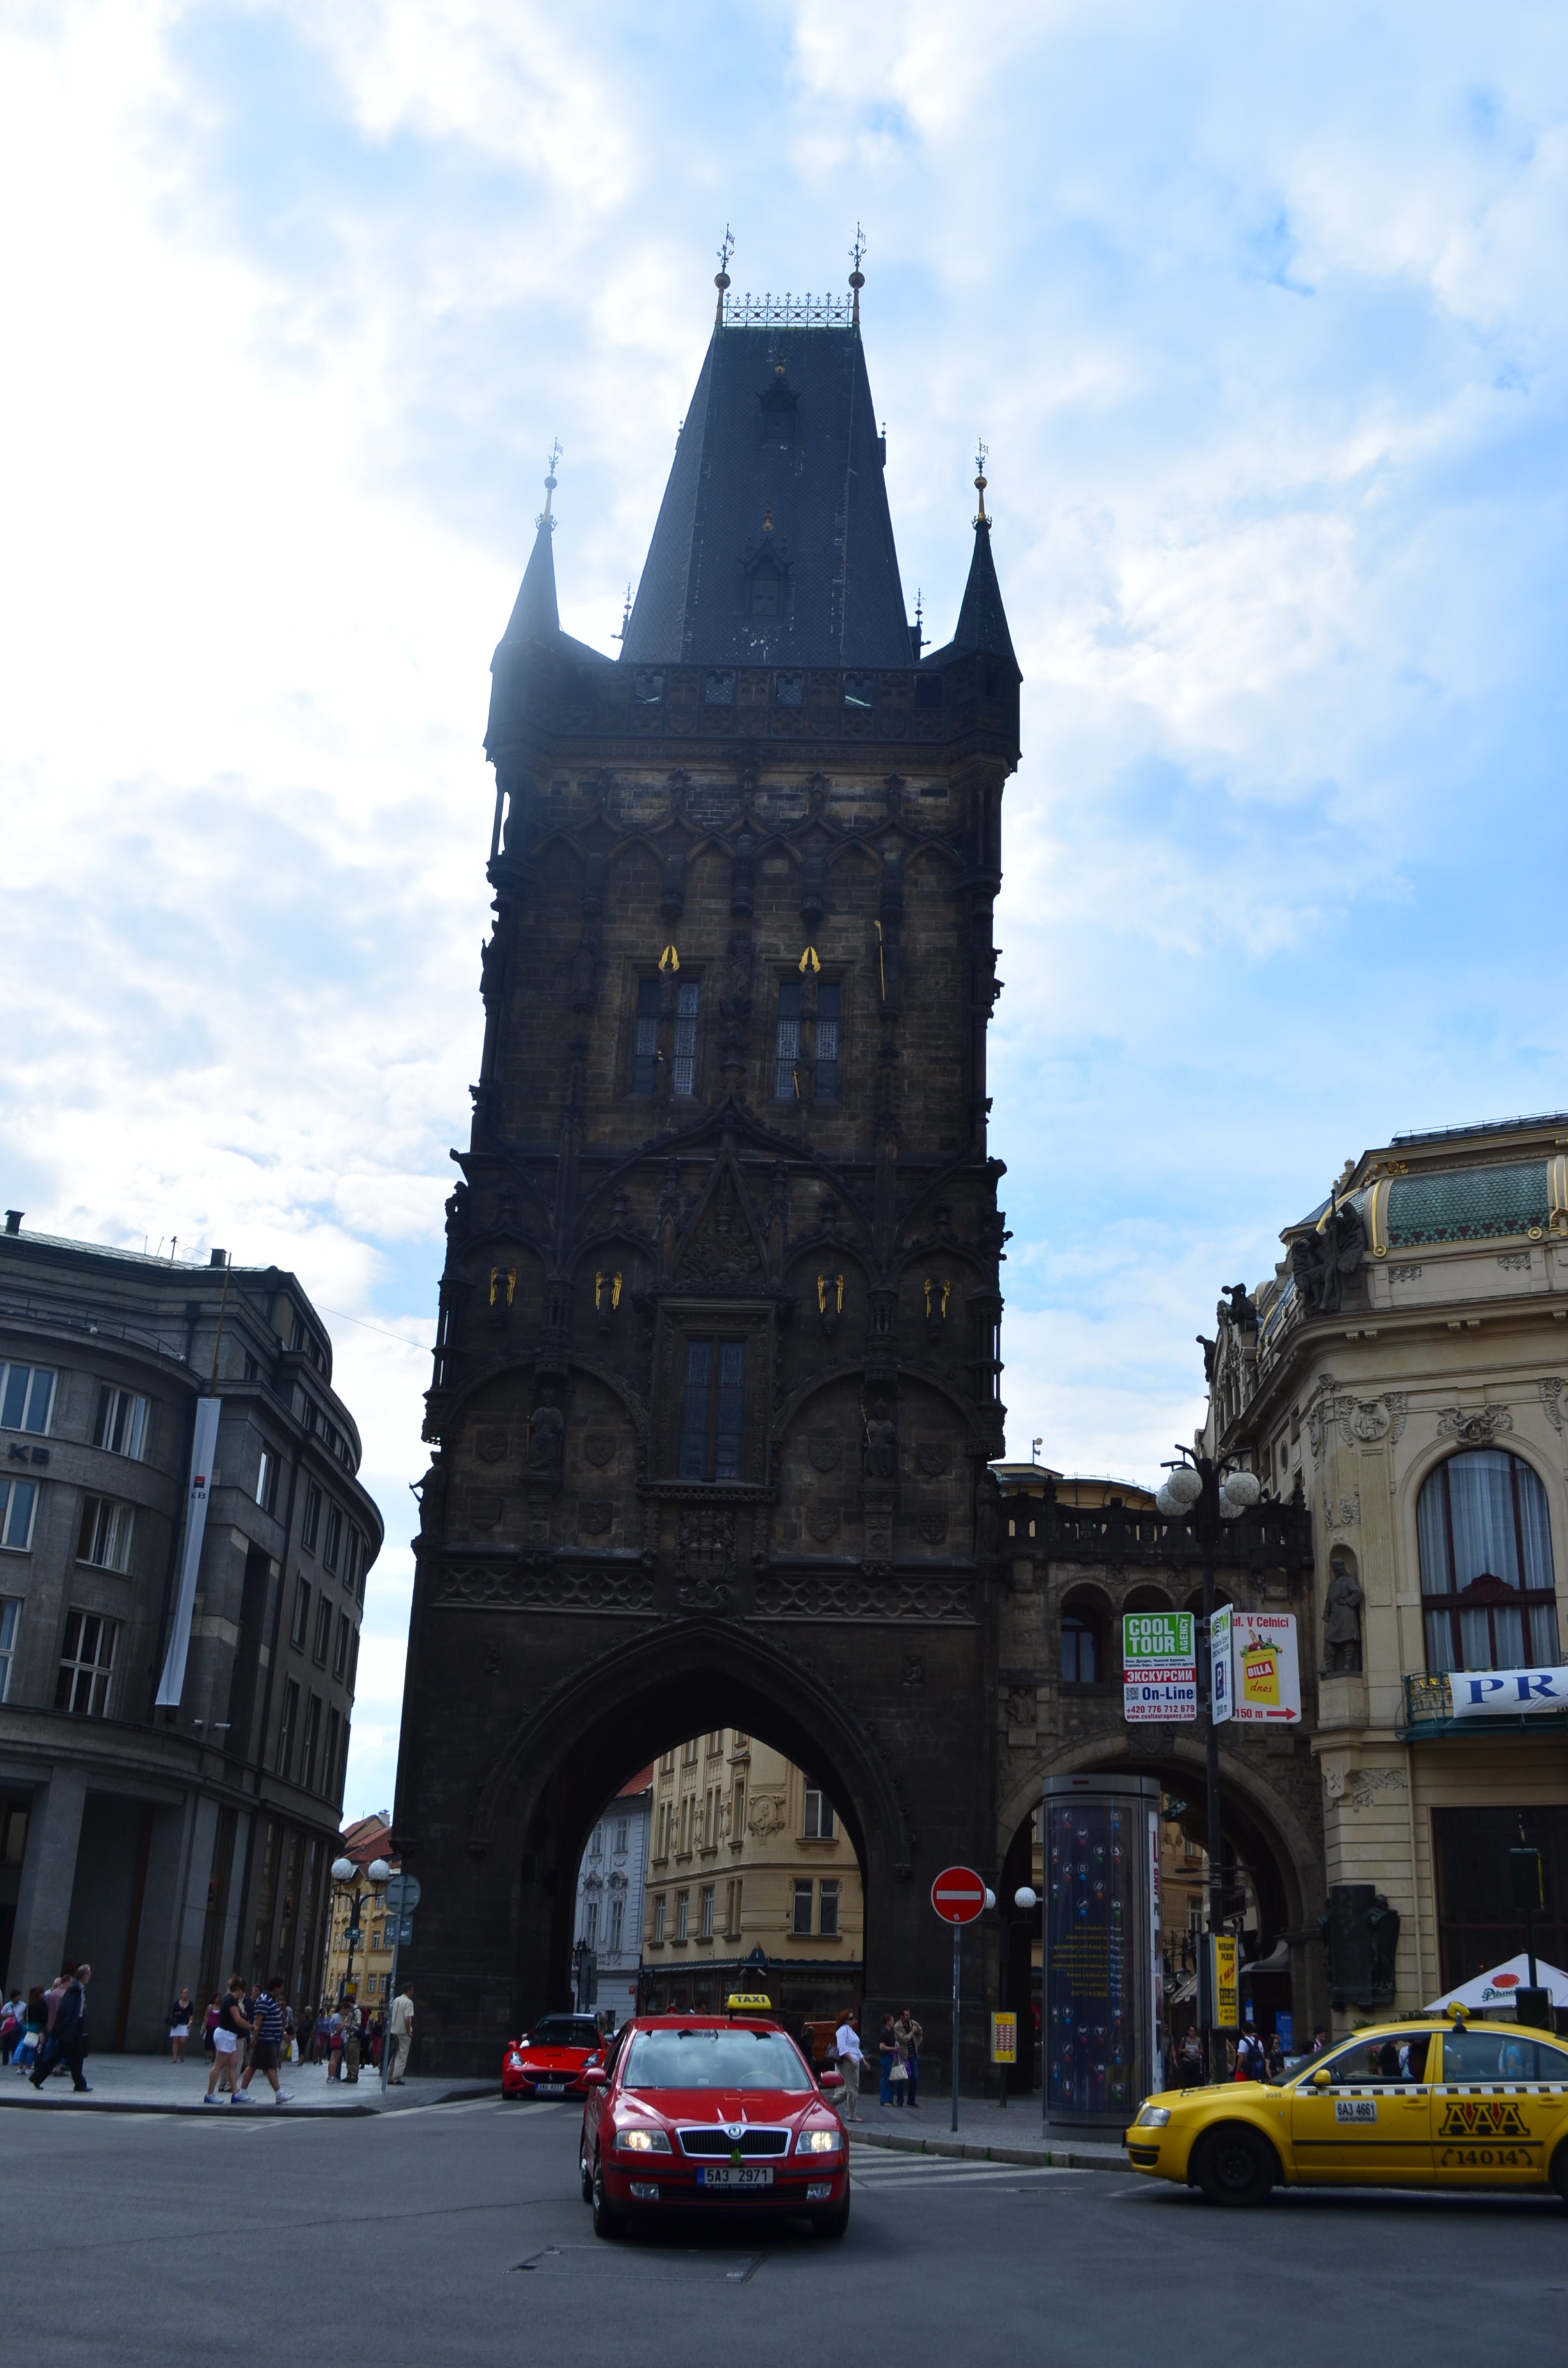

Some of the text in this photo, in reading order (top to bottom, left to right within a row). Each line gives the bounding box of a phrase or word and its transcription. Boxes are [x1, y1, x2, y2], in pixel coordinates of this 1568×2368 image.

[9, 1443, 49, 1464] KB
[1129, 1618, 1175, 1636] COOL
[1247, 1616, 1254, 1627] V
[1257, 1616, 1289, 1627] Celnici
[1179, 1618, 1189, 1652] AGENCY
[1129, 1636, 1175, 1654] TOUR
[1127, 1670, 1193, 1682] ЭКСКУРСИИ
[1247, 1663, 1273, 1677] BILLA
[1142, 1686, 1194, 1700] On-Line
[1250, 1681, 1273, 1693] dnes
[1465, 1674, 1568, 1704] PR
[1164, 1705, 1178, 1713] 712
[1180, 1704, 1195, 1713] 679
[1236, 1709, 1253, 1718] 150
[1337, 2103, 1375, 2116] 6A3 4661
[1439, 2102, 1531, 2136] AAA
[707, 2169, 767, 2182] 5A3 2971
